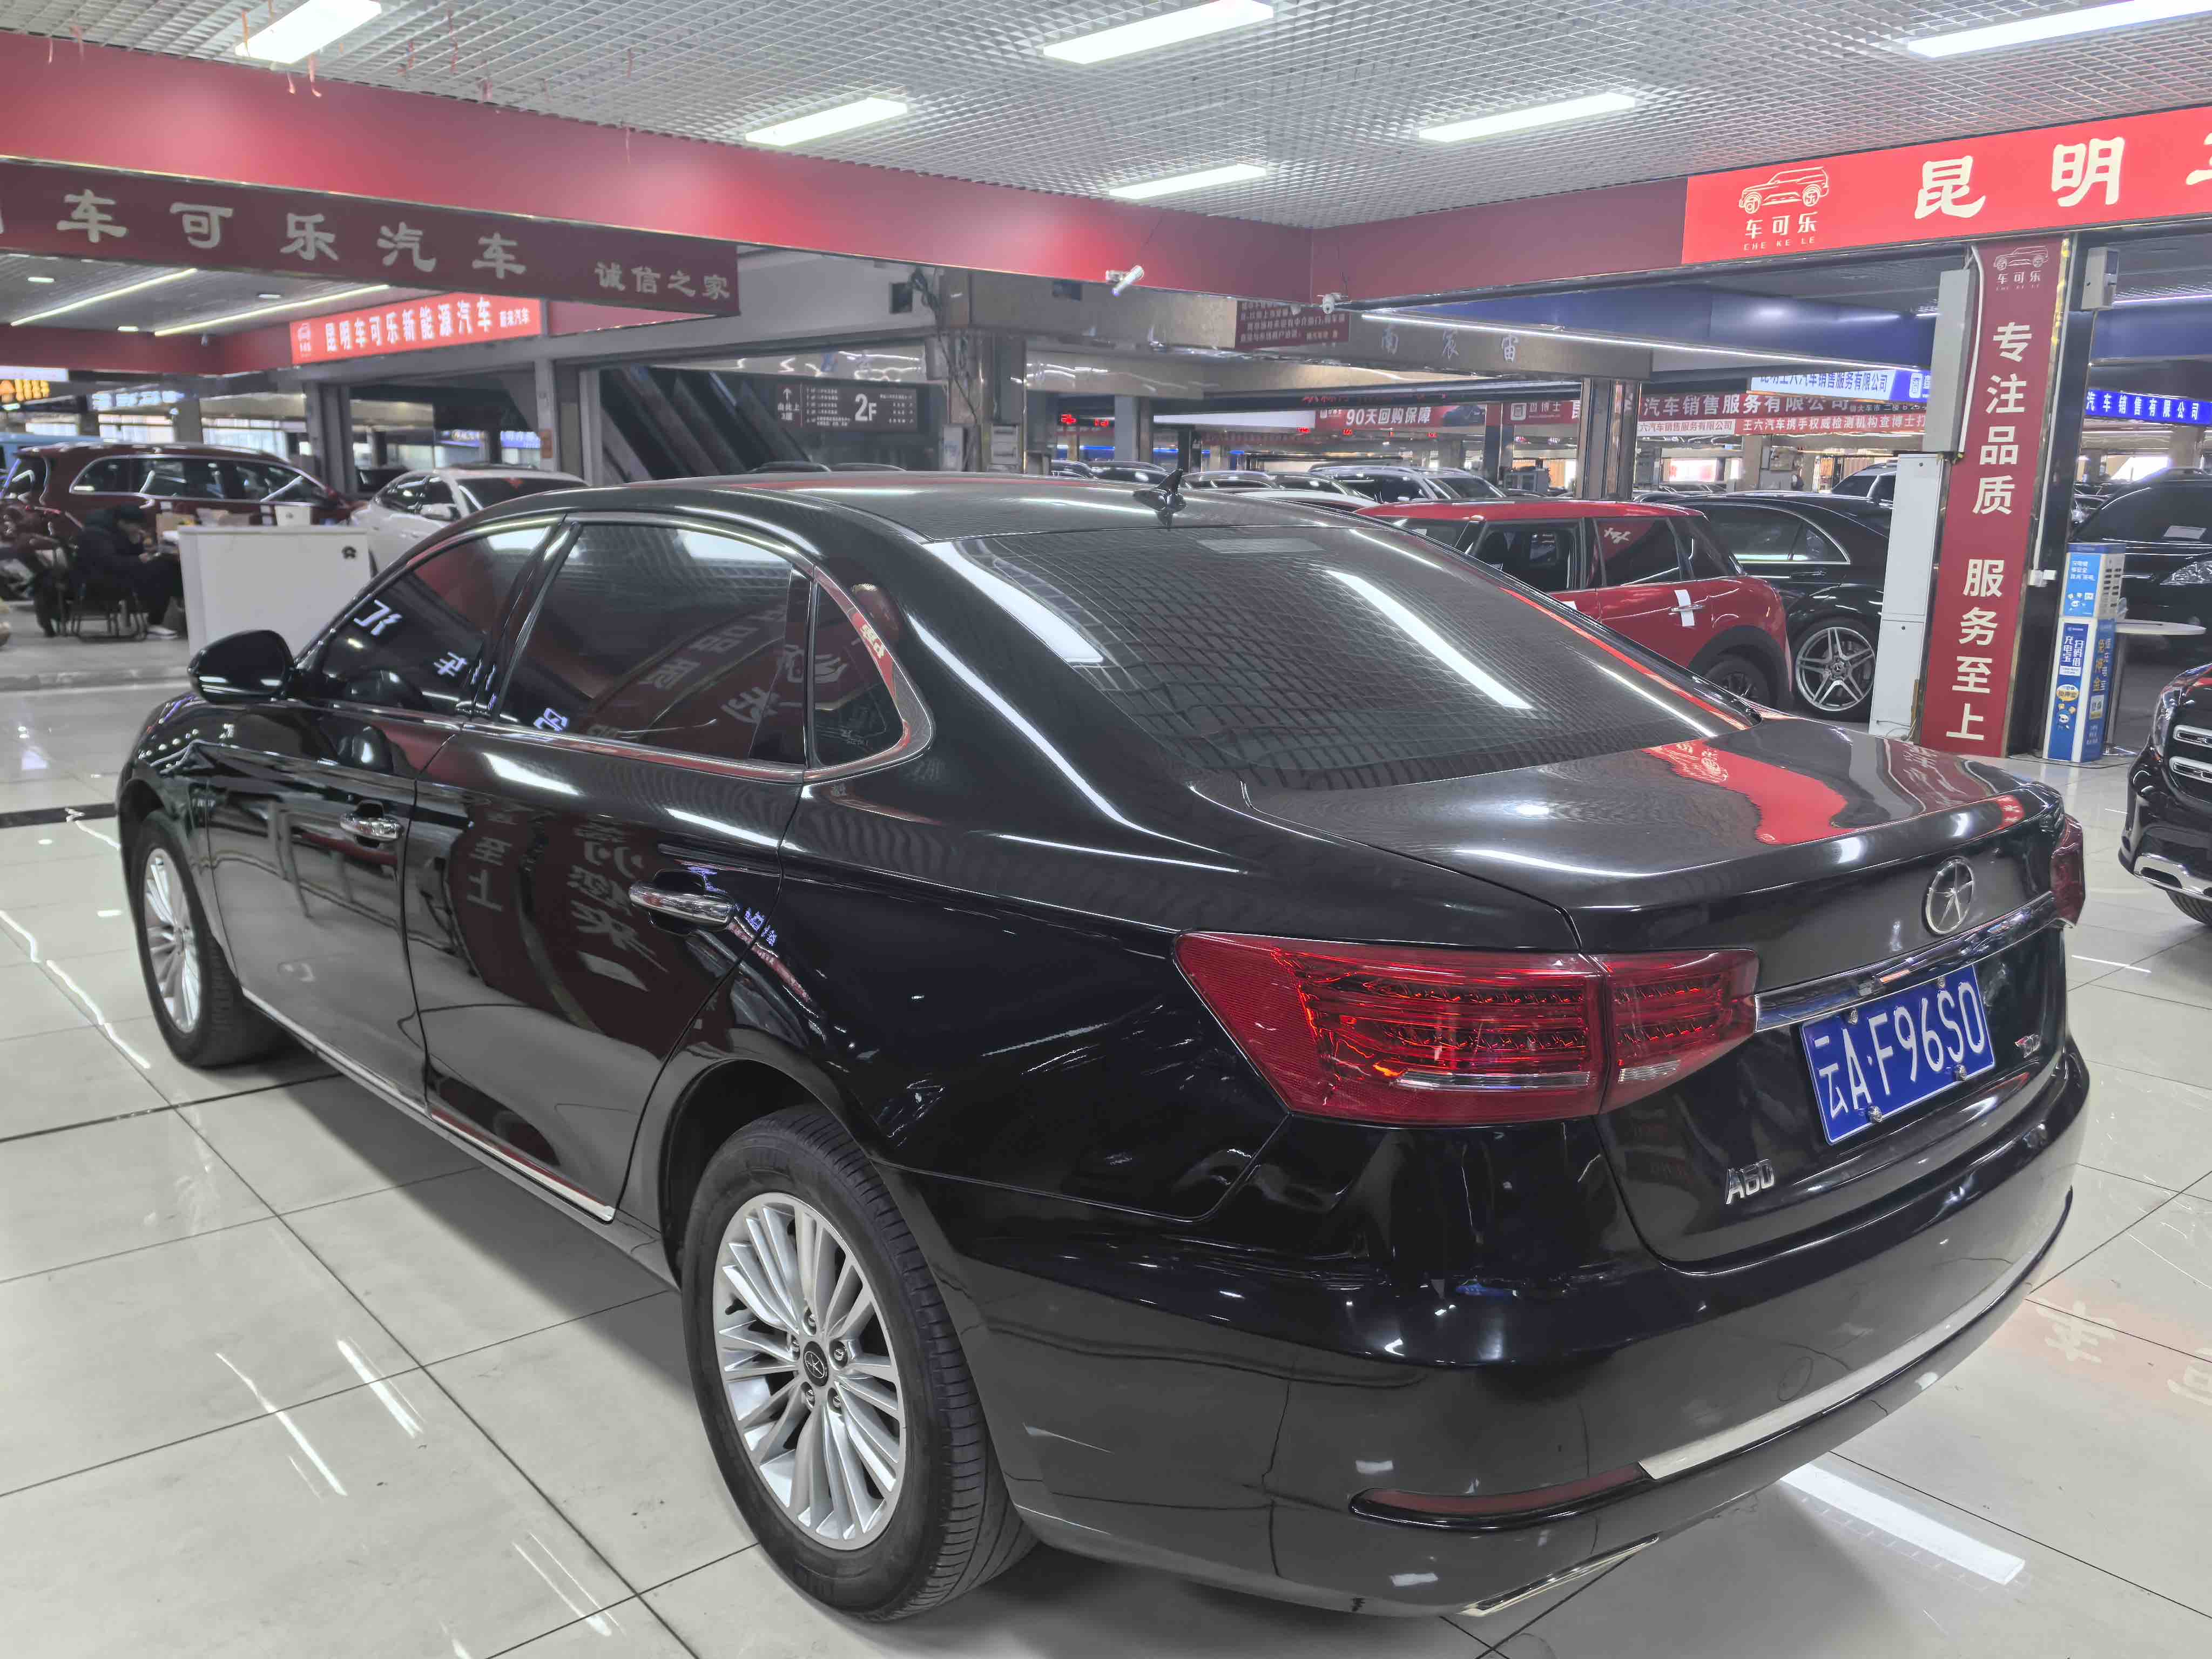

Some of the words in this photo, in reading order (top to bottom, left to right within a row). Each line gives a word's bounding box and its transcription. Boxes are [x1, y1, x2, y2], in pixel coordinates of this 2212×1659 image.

[0, 189, 526, 279] 车可乐汽车
[1745, 211, 1818, 239] 车可乐
[1744, 241, 1766, 251] CHE
[1776, 239, 1791, 247] KE
[1801, 236, 1815, 245] LE
[594, 262, 730, 301] 诚信之家
[1997, 270, 2042, 284] 车可乐
[855, 393, 878, 421] 2F
[1346, 406, 1431, 426] 90天回购保障
[1972, 321, 2033, 515] 专注品质
[1945, 558, 2006, 741] 服务至上
[1725, 1159, 1776, 1205] A60
